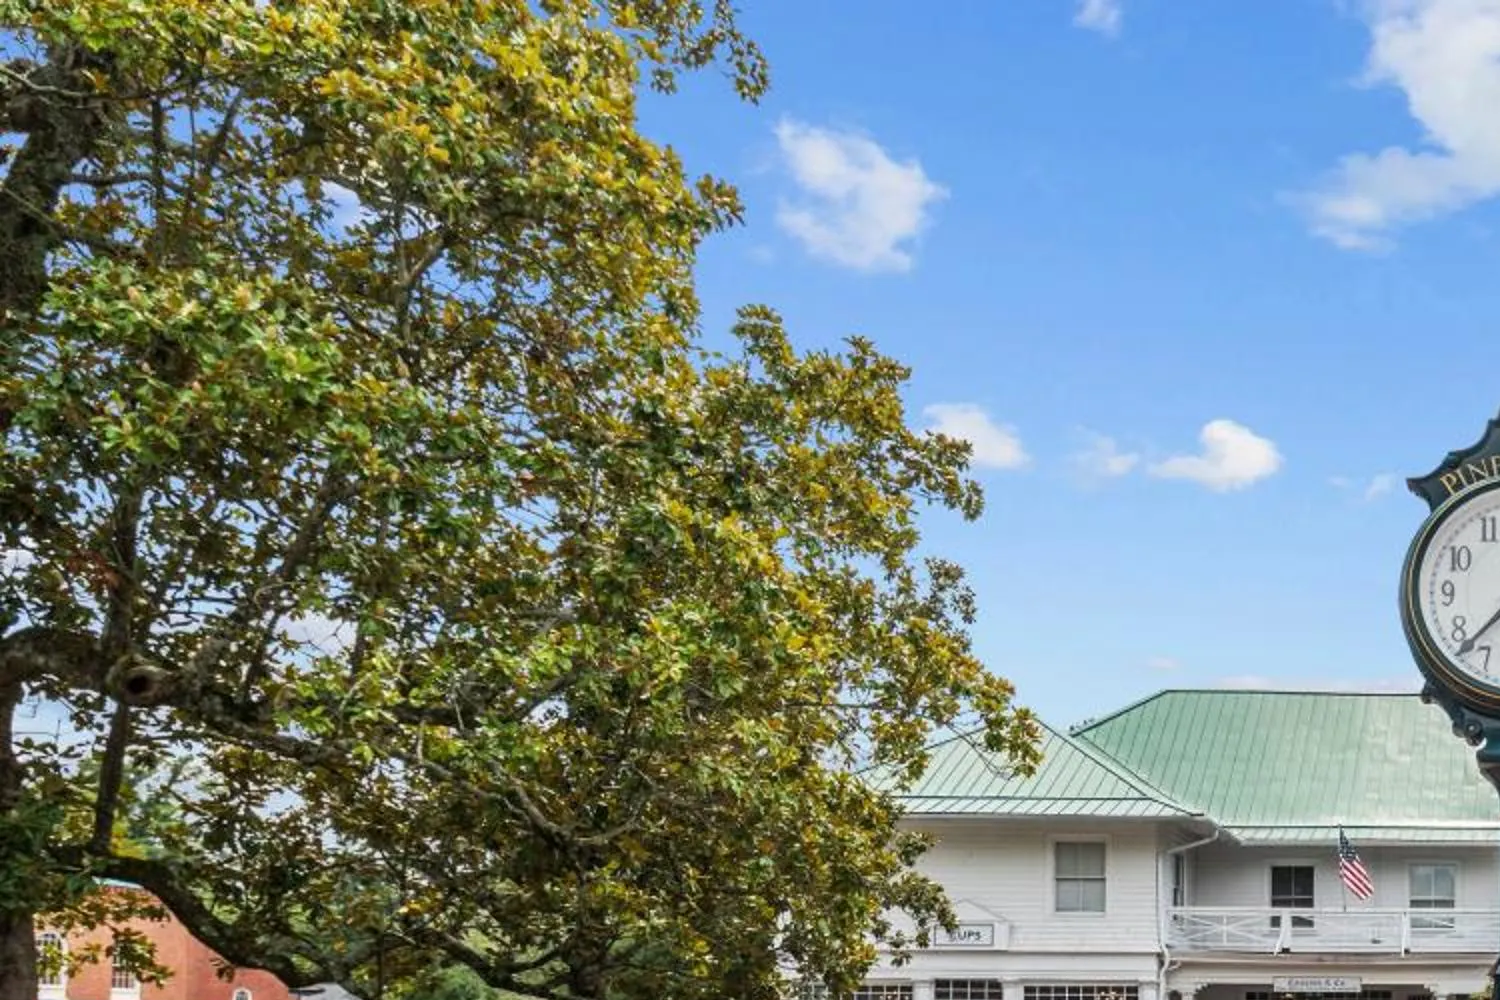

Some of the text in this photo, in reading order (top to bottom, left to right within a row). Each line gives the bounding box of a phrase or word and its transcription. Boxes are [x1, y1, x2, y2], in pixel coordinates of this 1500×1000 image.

[1480, 517, 1497, 542] 11
[1450, 546, 1471, 571] 10
[1441, 580, 1455, 606] 9
[1452, 616, 1467, 642] 8
[1478, 646, 1492, 671] 7
